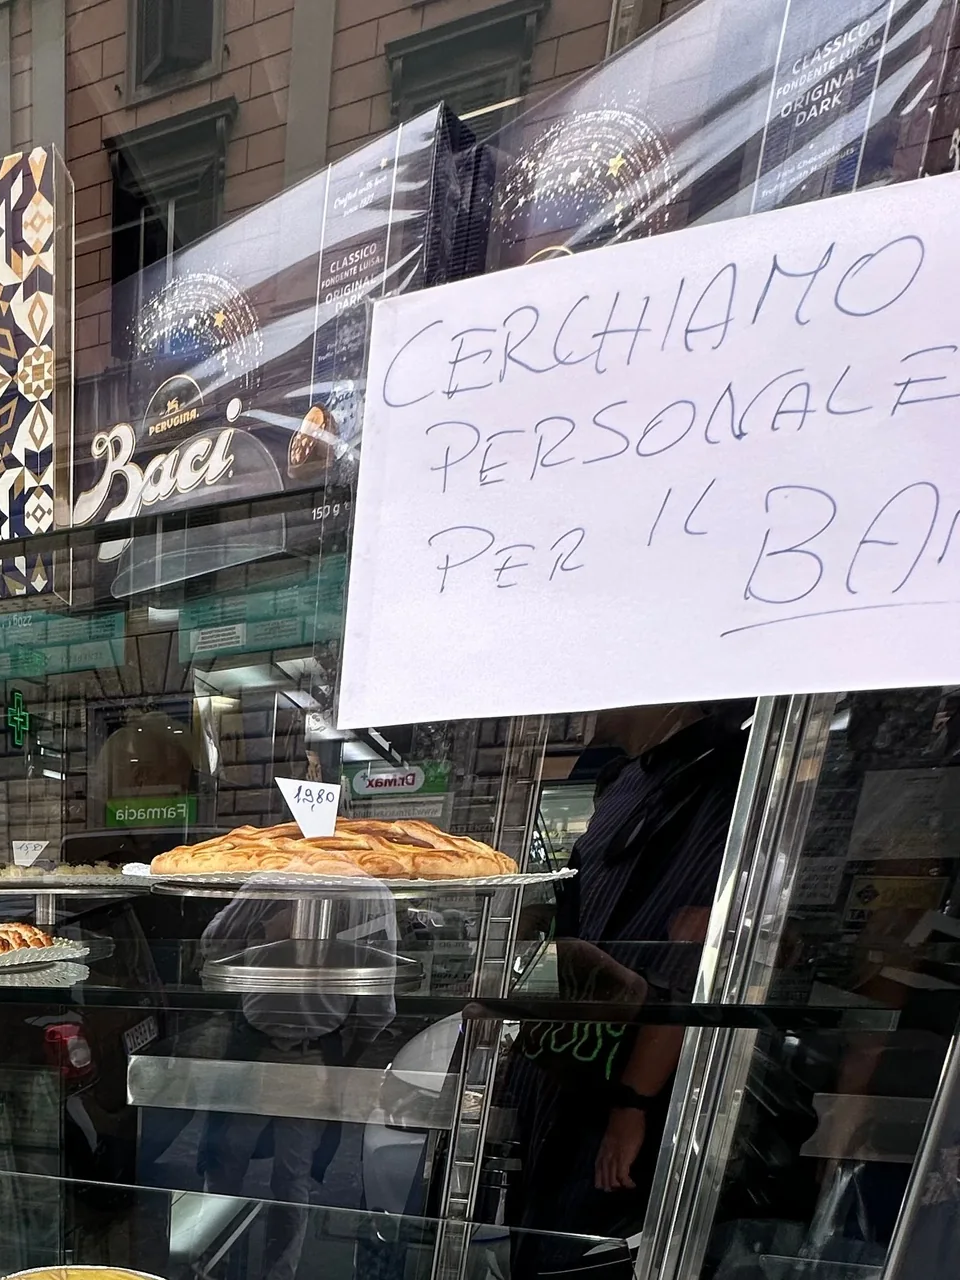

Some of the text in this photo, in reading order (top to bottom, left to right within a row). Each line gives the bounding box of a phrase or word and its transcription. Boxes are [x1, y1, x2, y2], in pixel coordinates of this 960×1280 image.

[791, 19, 871, 76] CLASSICO
[775, 58, 836, 100] FONDENTE
[780, 63, 866, 119] ORIGINAL
[794, 91, 844, 128] DARK
[329, 242, 377, 274] CLASSICO
[320, 264, 358, 290] FONDENTE
[324, 273, 377, 305] ORIGINAL
[334, 290, 365, 313] DARK
[384, 234, 926, 408] CERCHIAMO
[148, 407, 200, 437] PERUGINA
[426, 343, 960, 494] PERSONALE
[72, 396, 244, 564] Baci
[311, 506, 331, 521] 150
[332, 503, 341, 517] g
[427, 525, 586, 594] PER
[646, 477, 717, 549] IL
[293, 785, 335, 813] 19,80
